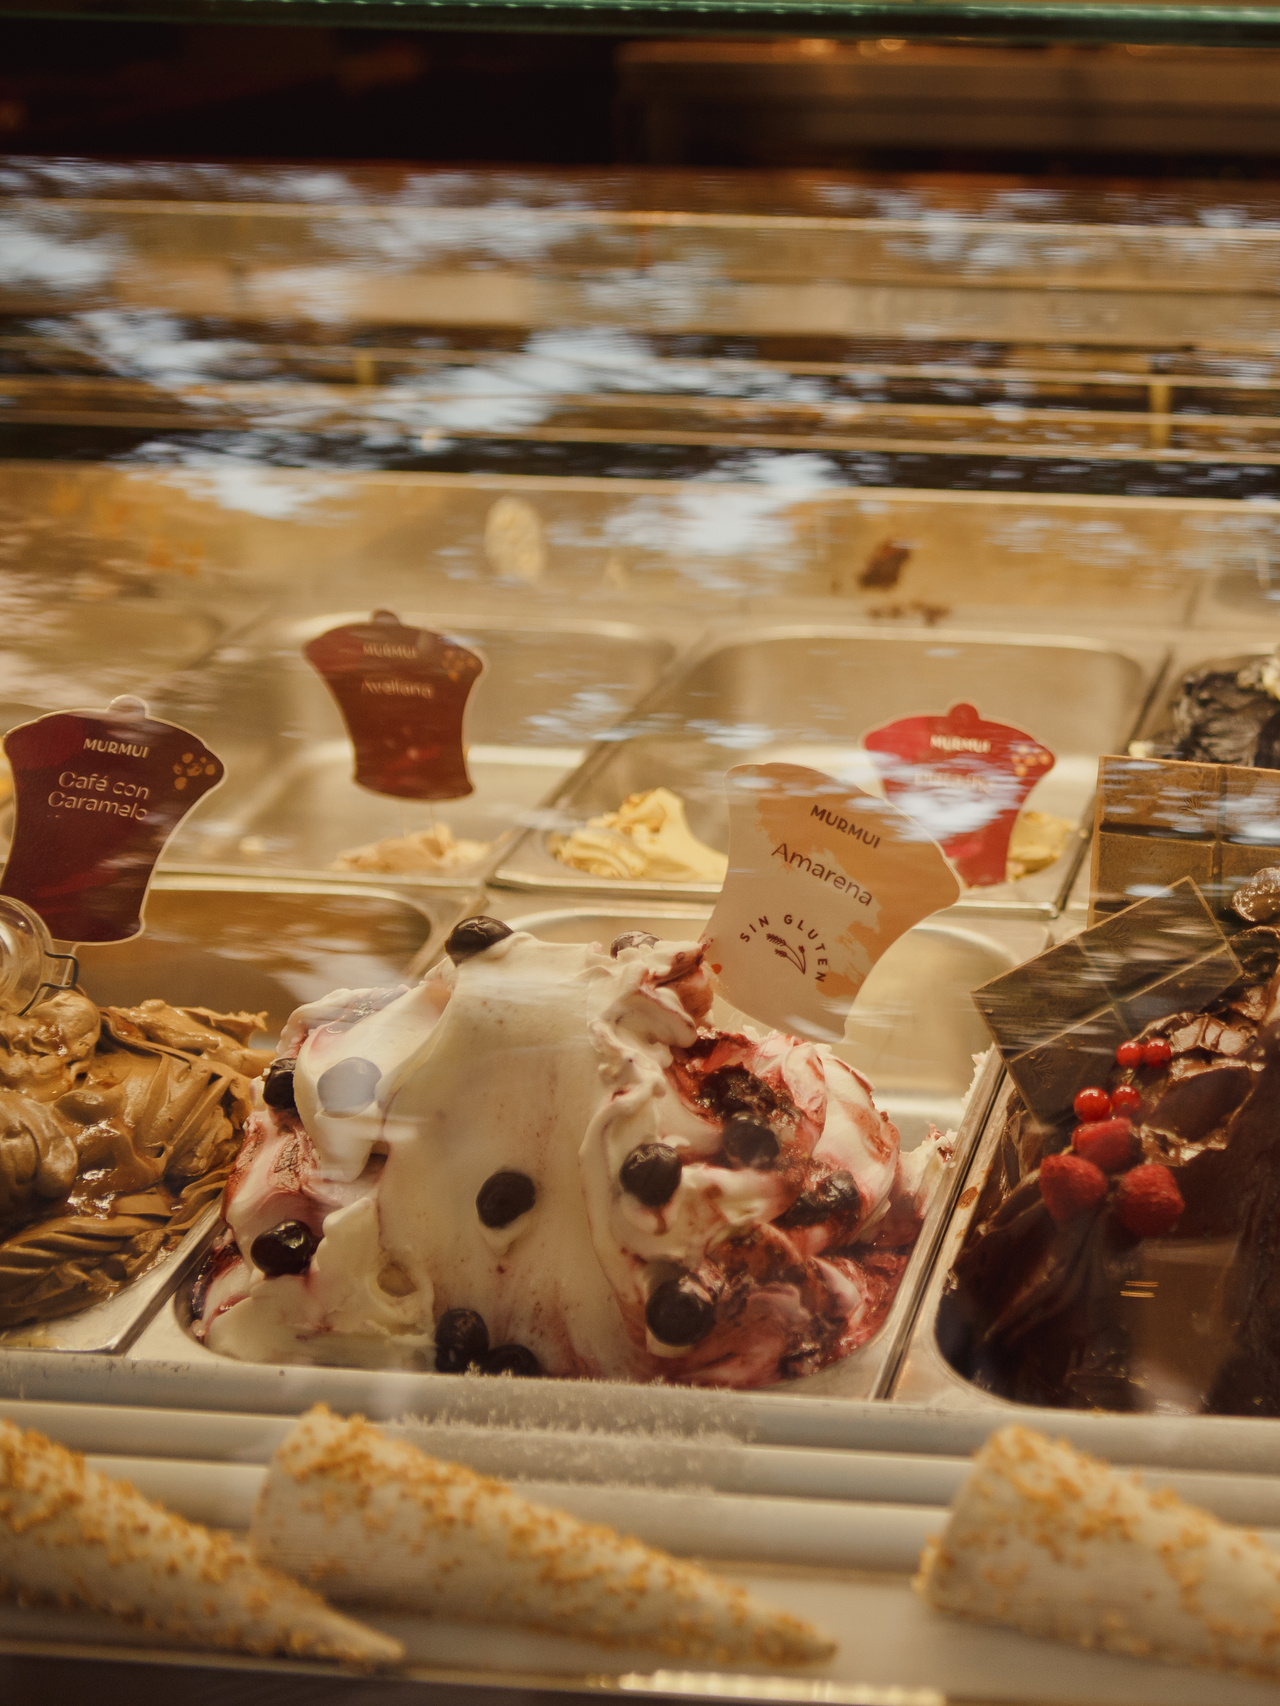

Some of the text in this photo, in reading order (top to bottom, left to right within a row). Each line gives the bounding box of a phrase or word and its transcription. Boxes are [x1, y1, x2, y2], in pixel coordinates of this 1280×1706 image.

[362, 643, 418, 659] MURMUI
[361, 679, 434, 699] Avellana
[83, 738, 150, 758] MURMUI
[58, 771, 150, 800] Café con
[47, 790, 149, 821] Caramelo
[810, 804, 881, 849] MURMUI
[770, 842, 874, 907] Amarena
[739, 914, 828, 983] SIN GLUTEN
